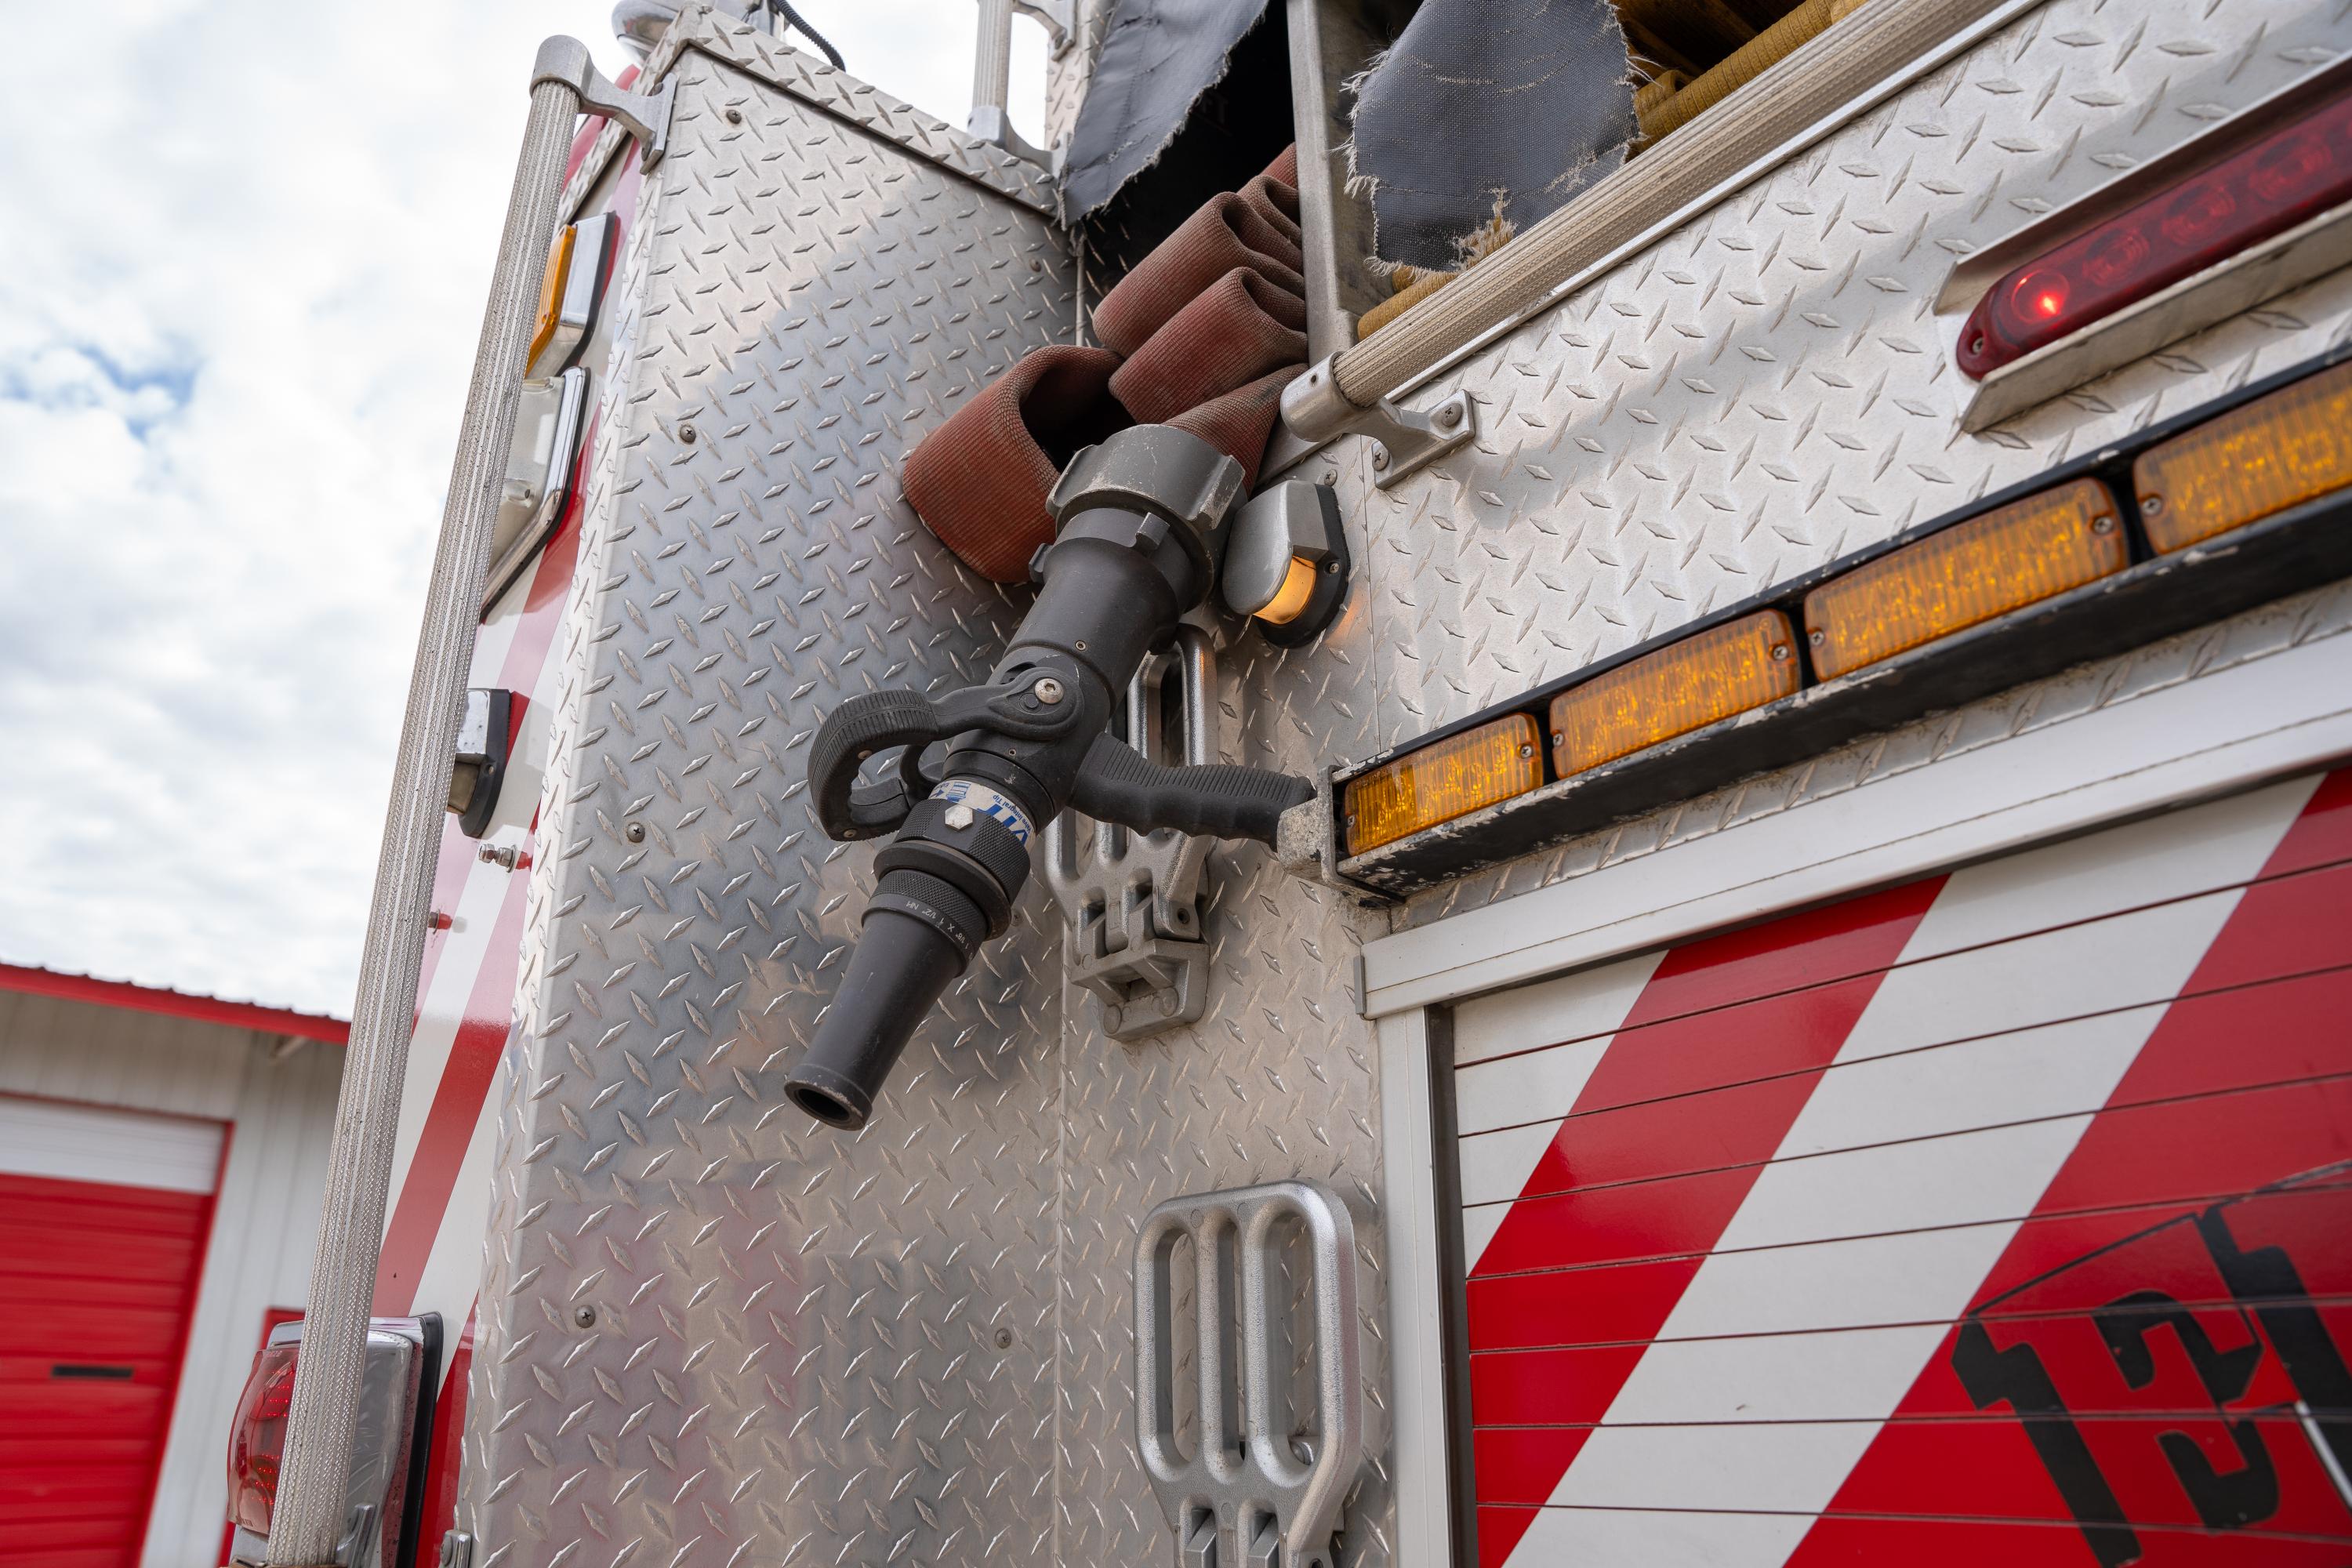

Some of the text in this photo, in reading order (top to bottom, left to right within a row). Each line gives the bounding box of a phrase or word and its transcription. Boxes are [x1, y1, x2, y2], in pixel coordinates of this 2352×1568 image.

[993, 794, 1003, 804] Tip
[1002, 802, 1022, 820] Integral
[906, 900, 920, 910] NH
